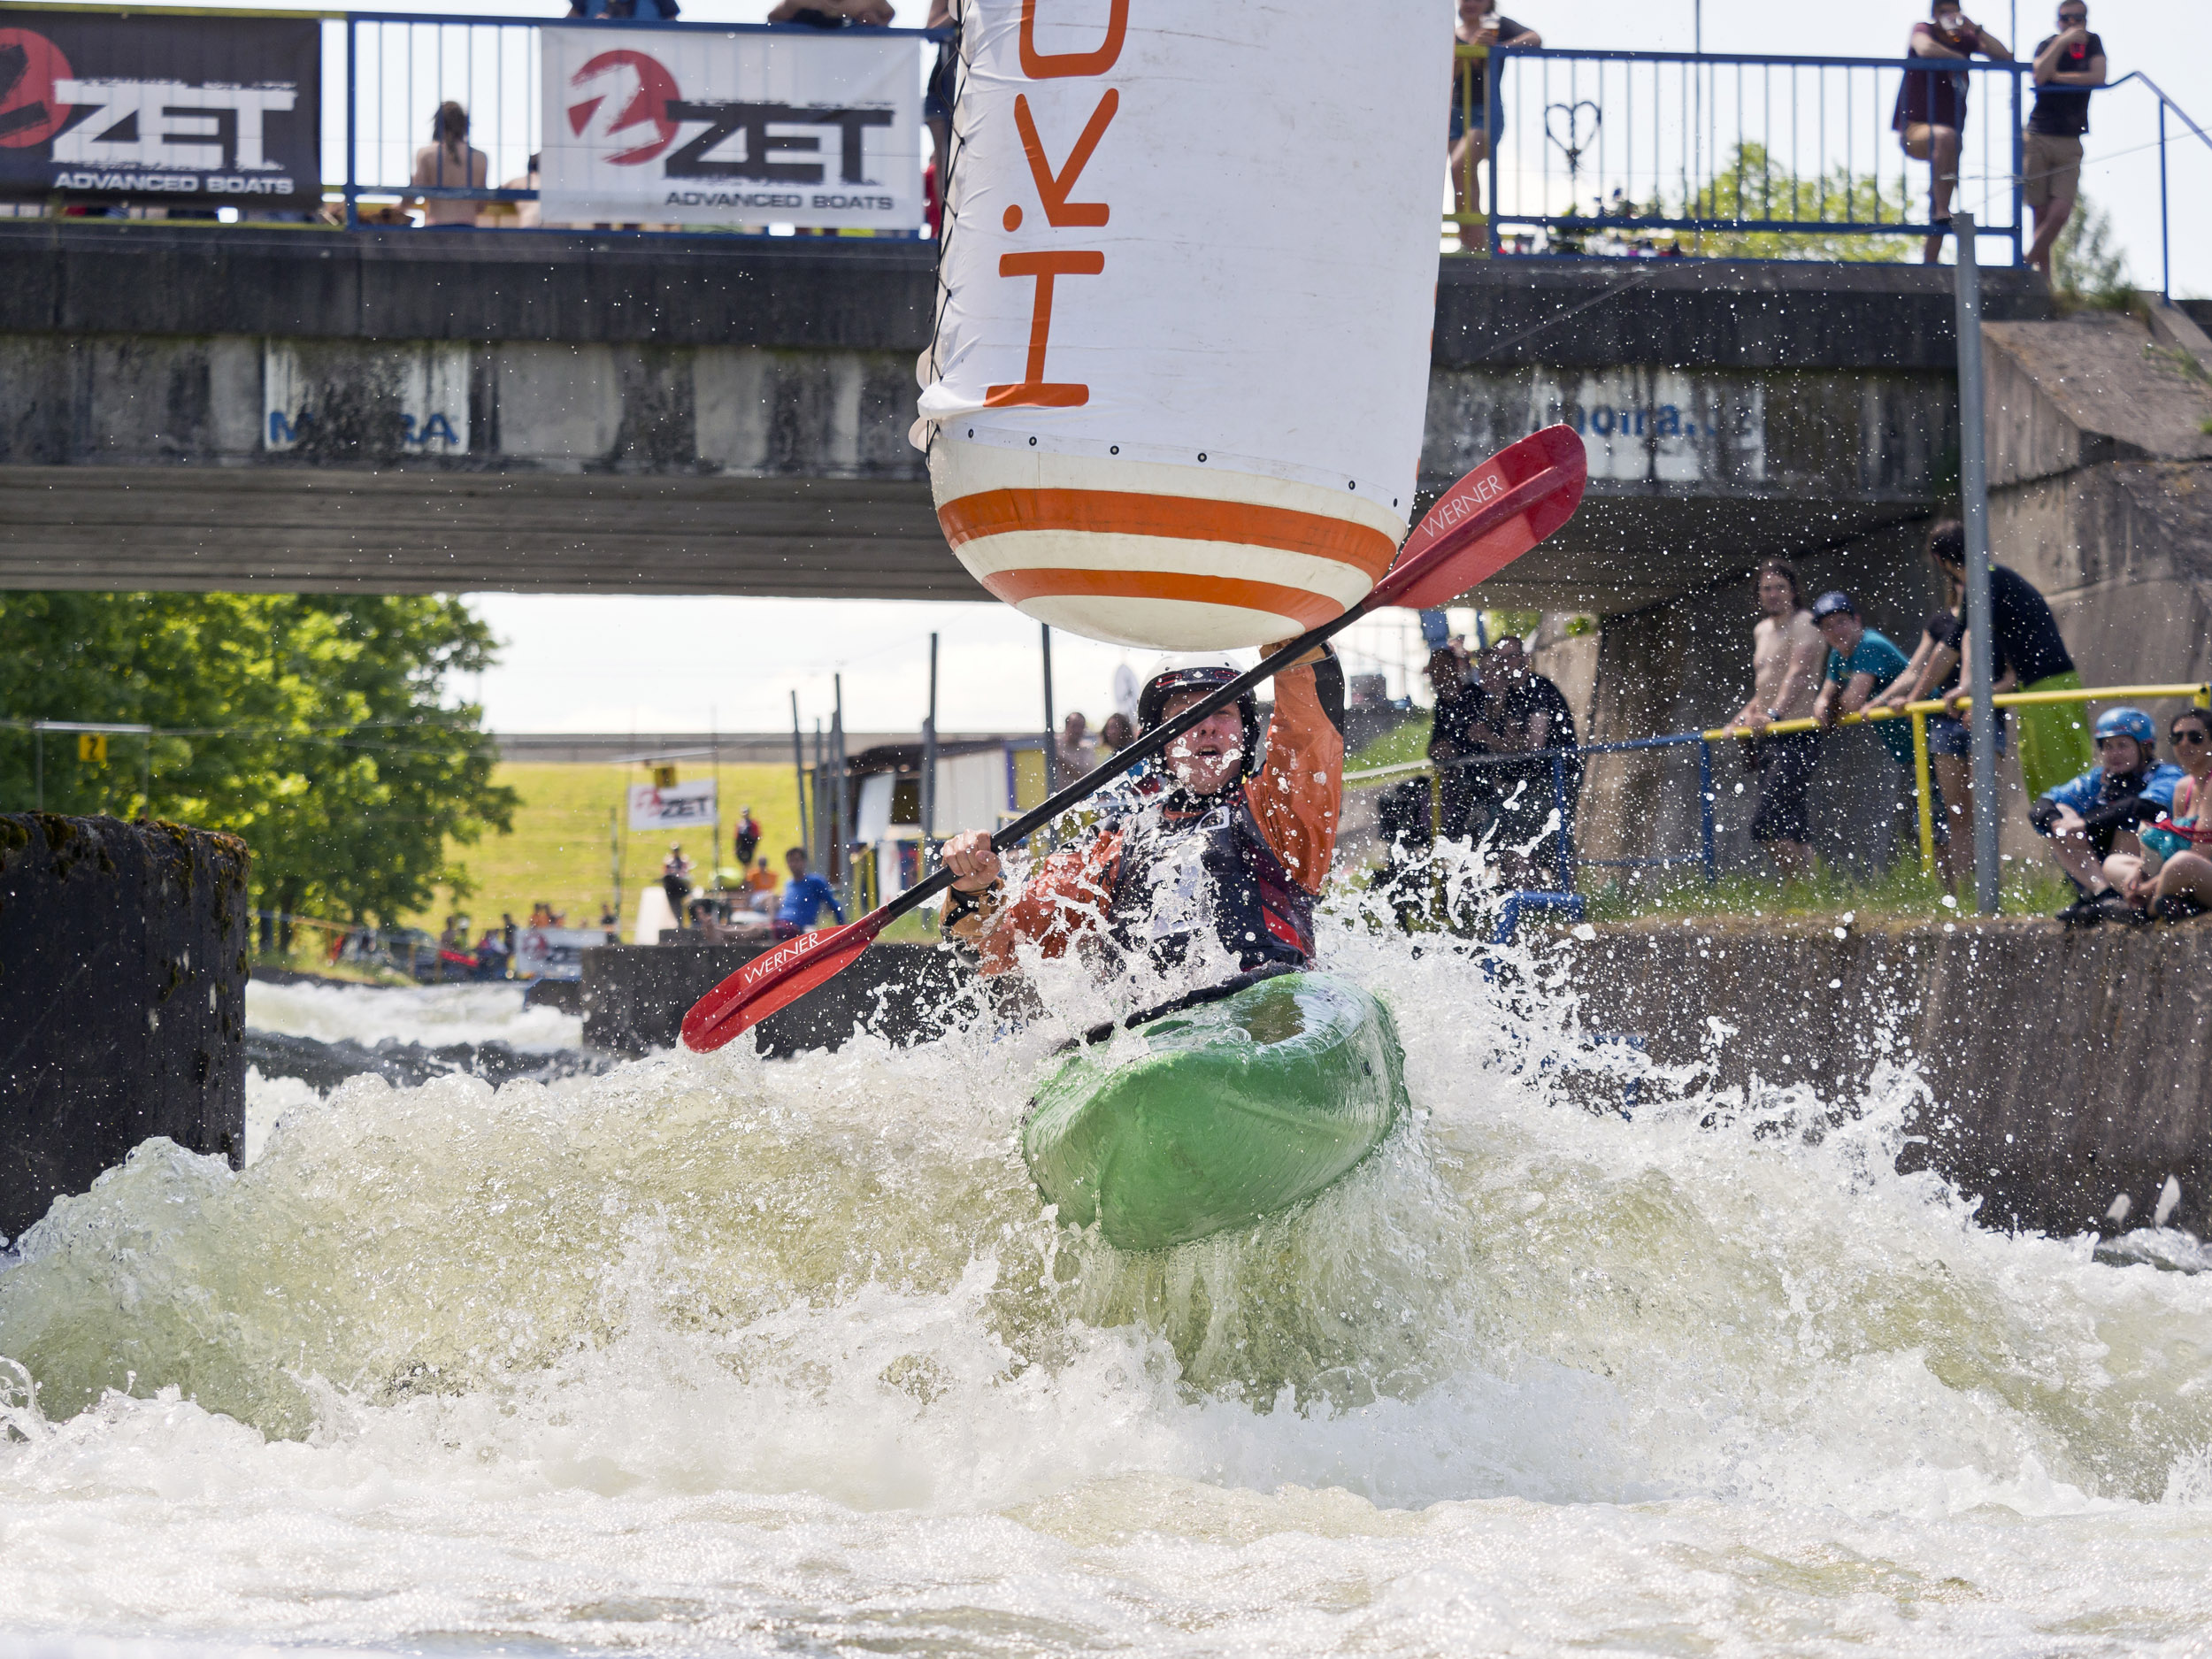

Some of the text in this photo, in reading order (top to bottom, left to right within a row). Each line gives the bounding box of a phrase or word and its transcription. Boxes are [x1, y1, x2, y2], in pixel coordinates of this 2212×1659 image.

[52, 78, 297, 171] ZET
[664, 100, 895, 186] ZET
[53, 172, 295, 195] ADVANCED BOATS
[664, 191, 894, 211] ADVANCED BOATS
[1420, 474, 1503, 538] WERNER
[659, 795, 710, 819] ZET
[744, 932, 818, 984] WERNER
